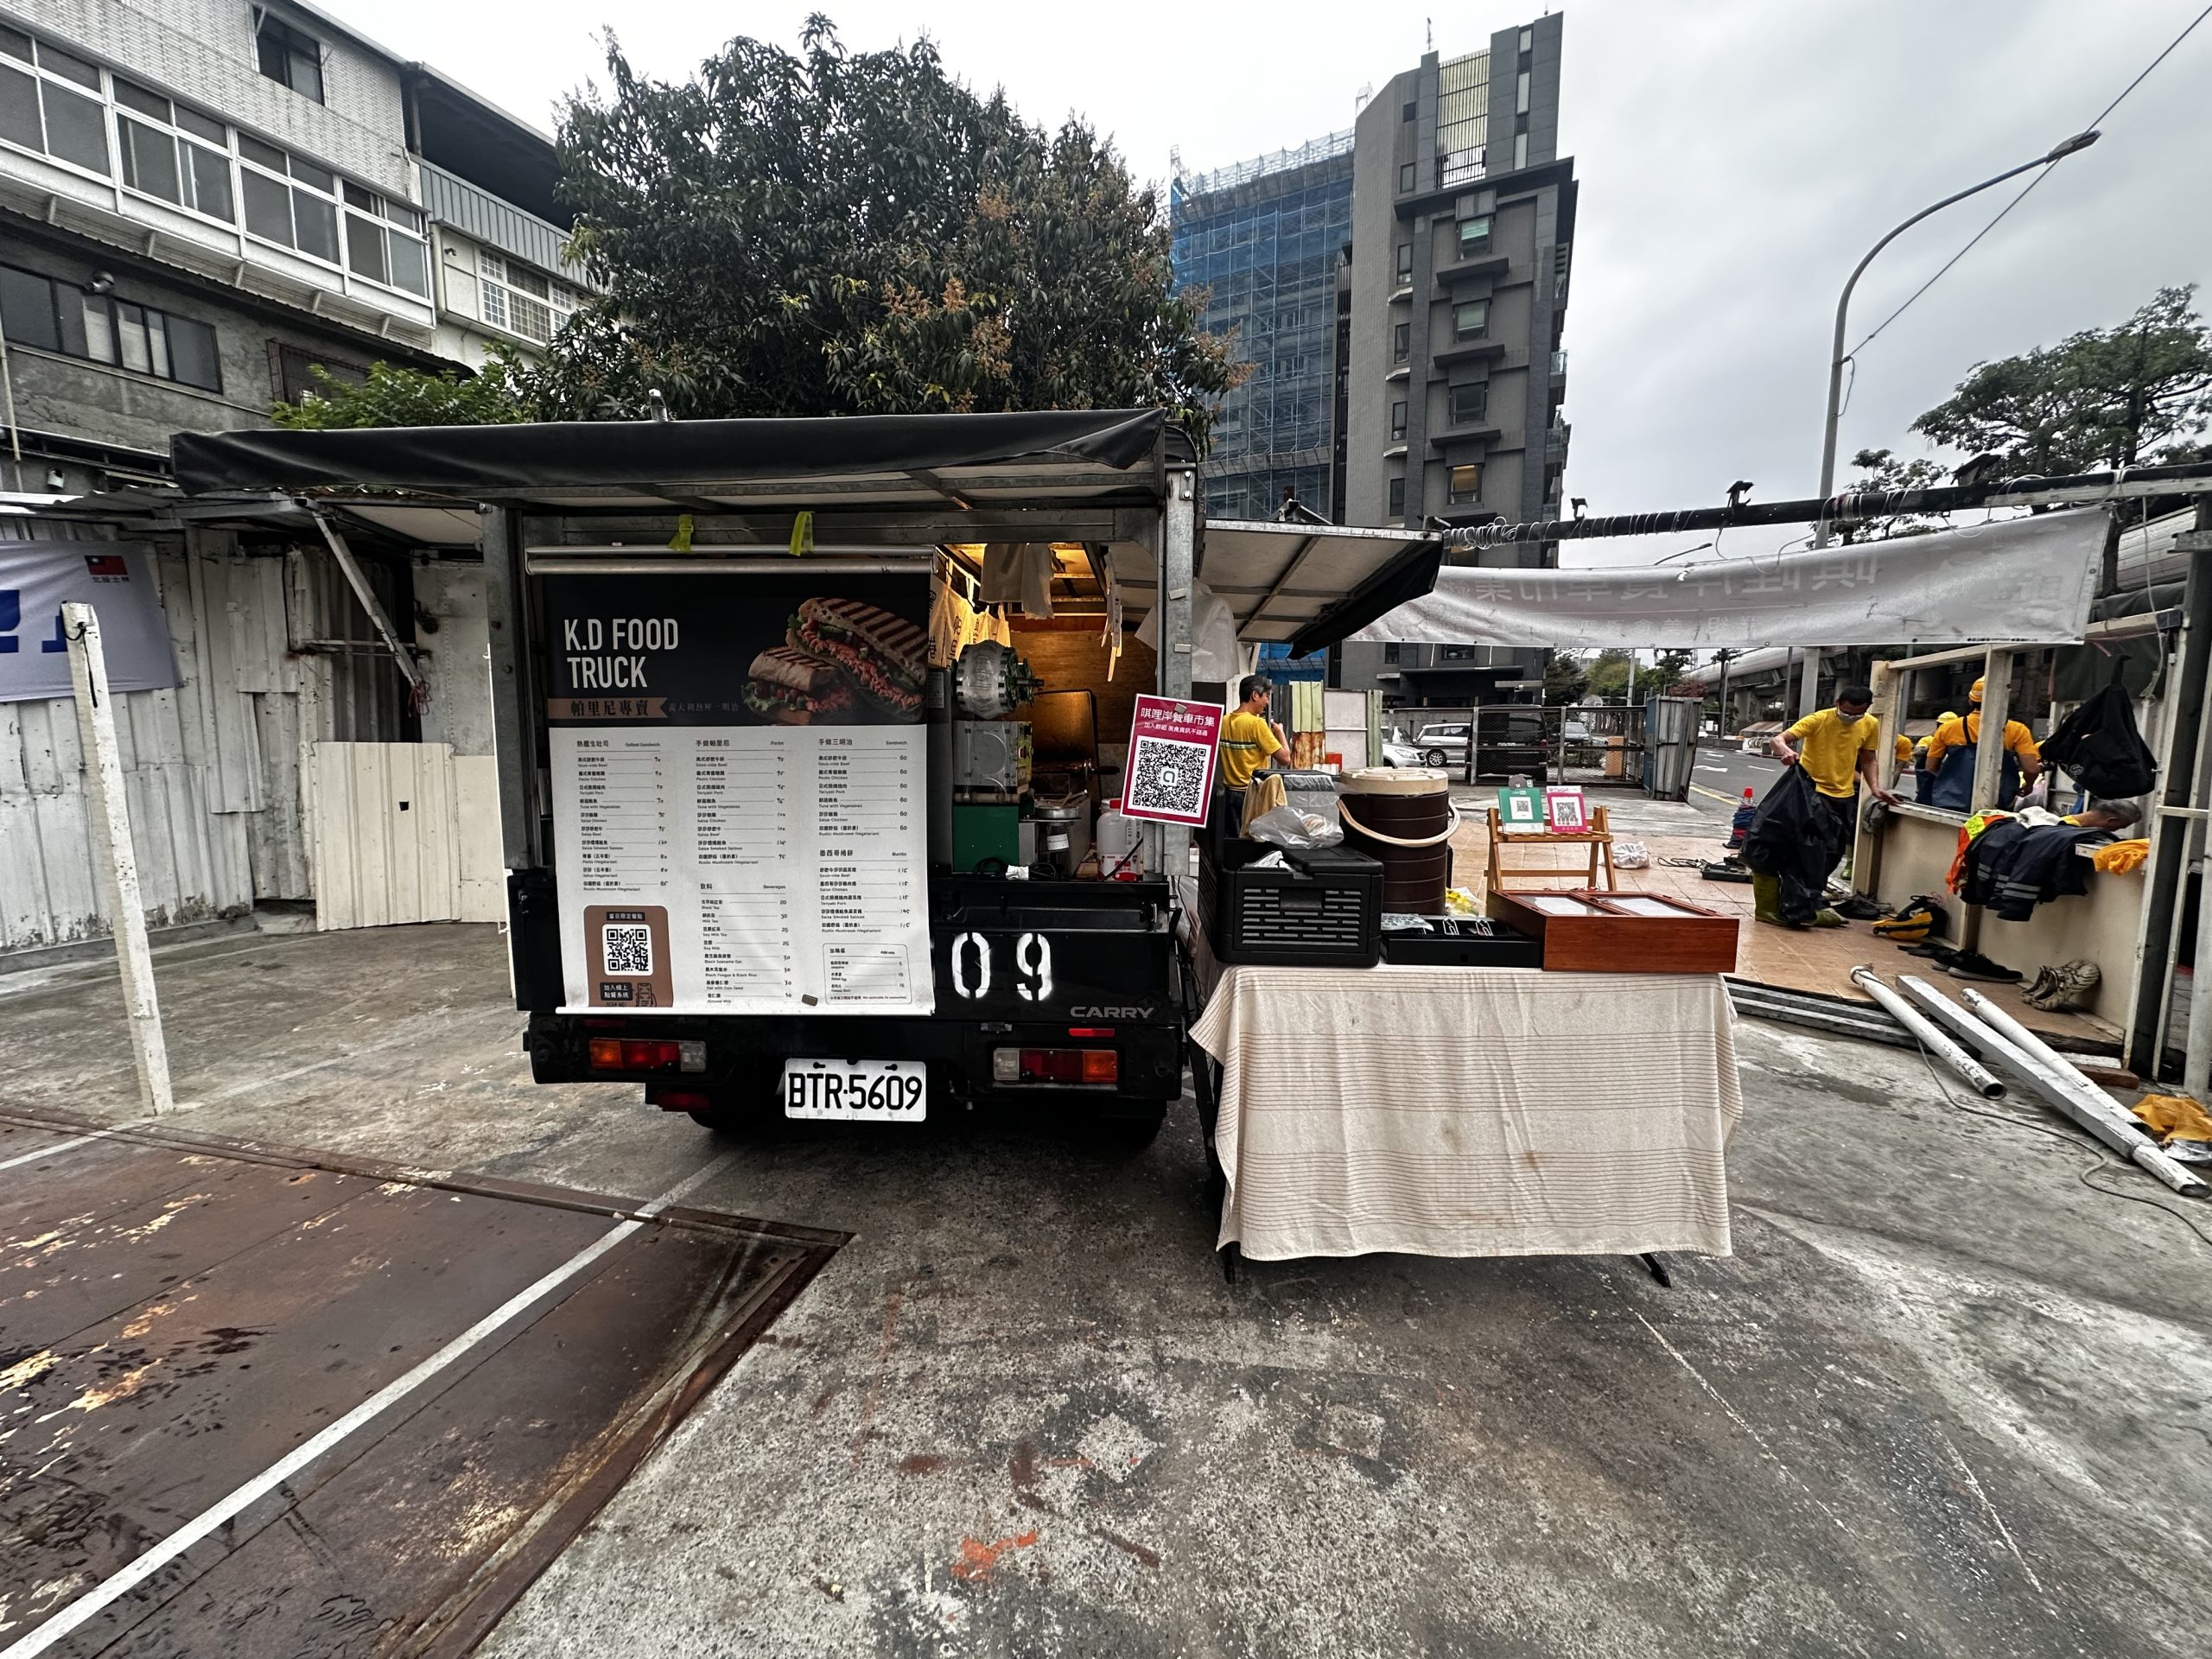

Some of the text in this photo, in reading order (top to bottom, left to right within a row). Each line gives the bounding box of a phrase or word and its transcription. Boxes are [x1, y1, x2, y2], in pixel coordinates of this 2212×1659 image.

[565, 618, 678, 651] K.D FOOD
[568, 655, 648, 688] TRUCK
[571, 701, 648, 716] 帕里尼專賣
[1141, 708, 1215, 727] 唭哩岸餐車市集
[1071, 1007, 1154, 1018] CARRY
